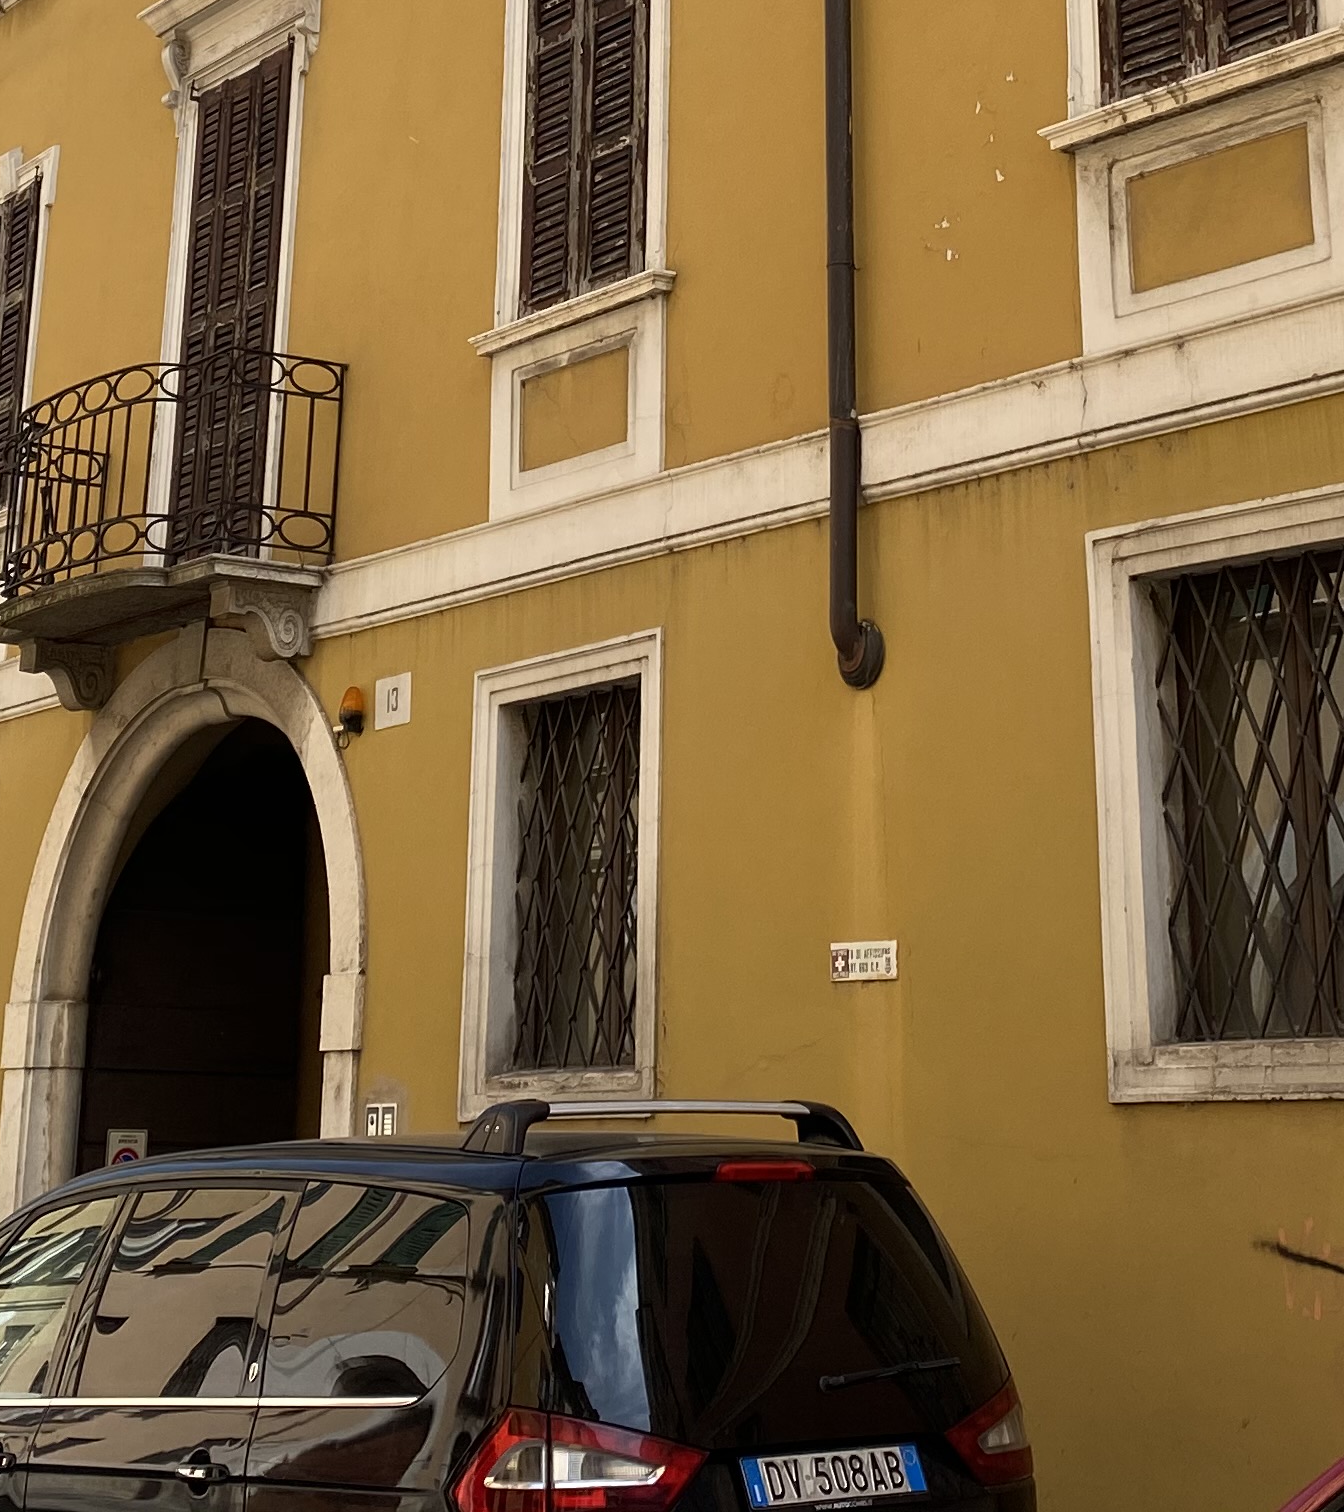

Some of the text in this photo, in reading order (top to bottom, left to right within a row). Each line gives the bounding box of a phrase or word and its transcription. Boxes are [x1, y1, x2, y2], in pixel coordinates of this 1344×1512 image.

[387, 687, 398, 713] 13
[763, 1451, 906, 1501] DV 508AB
